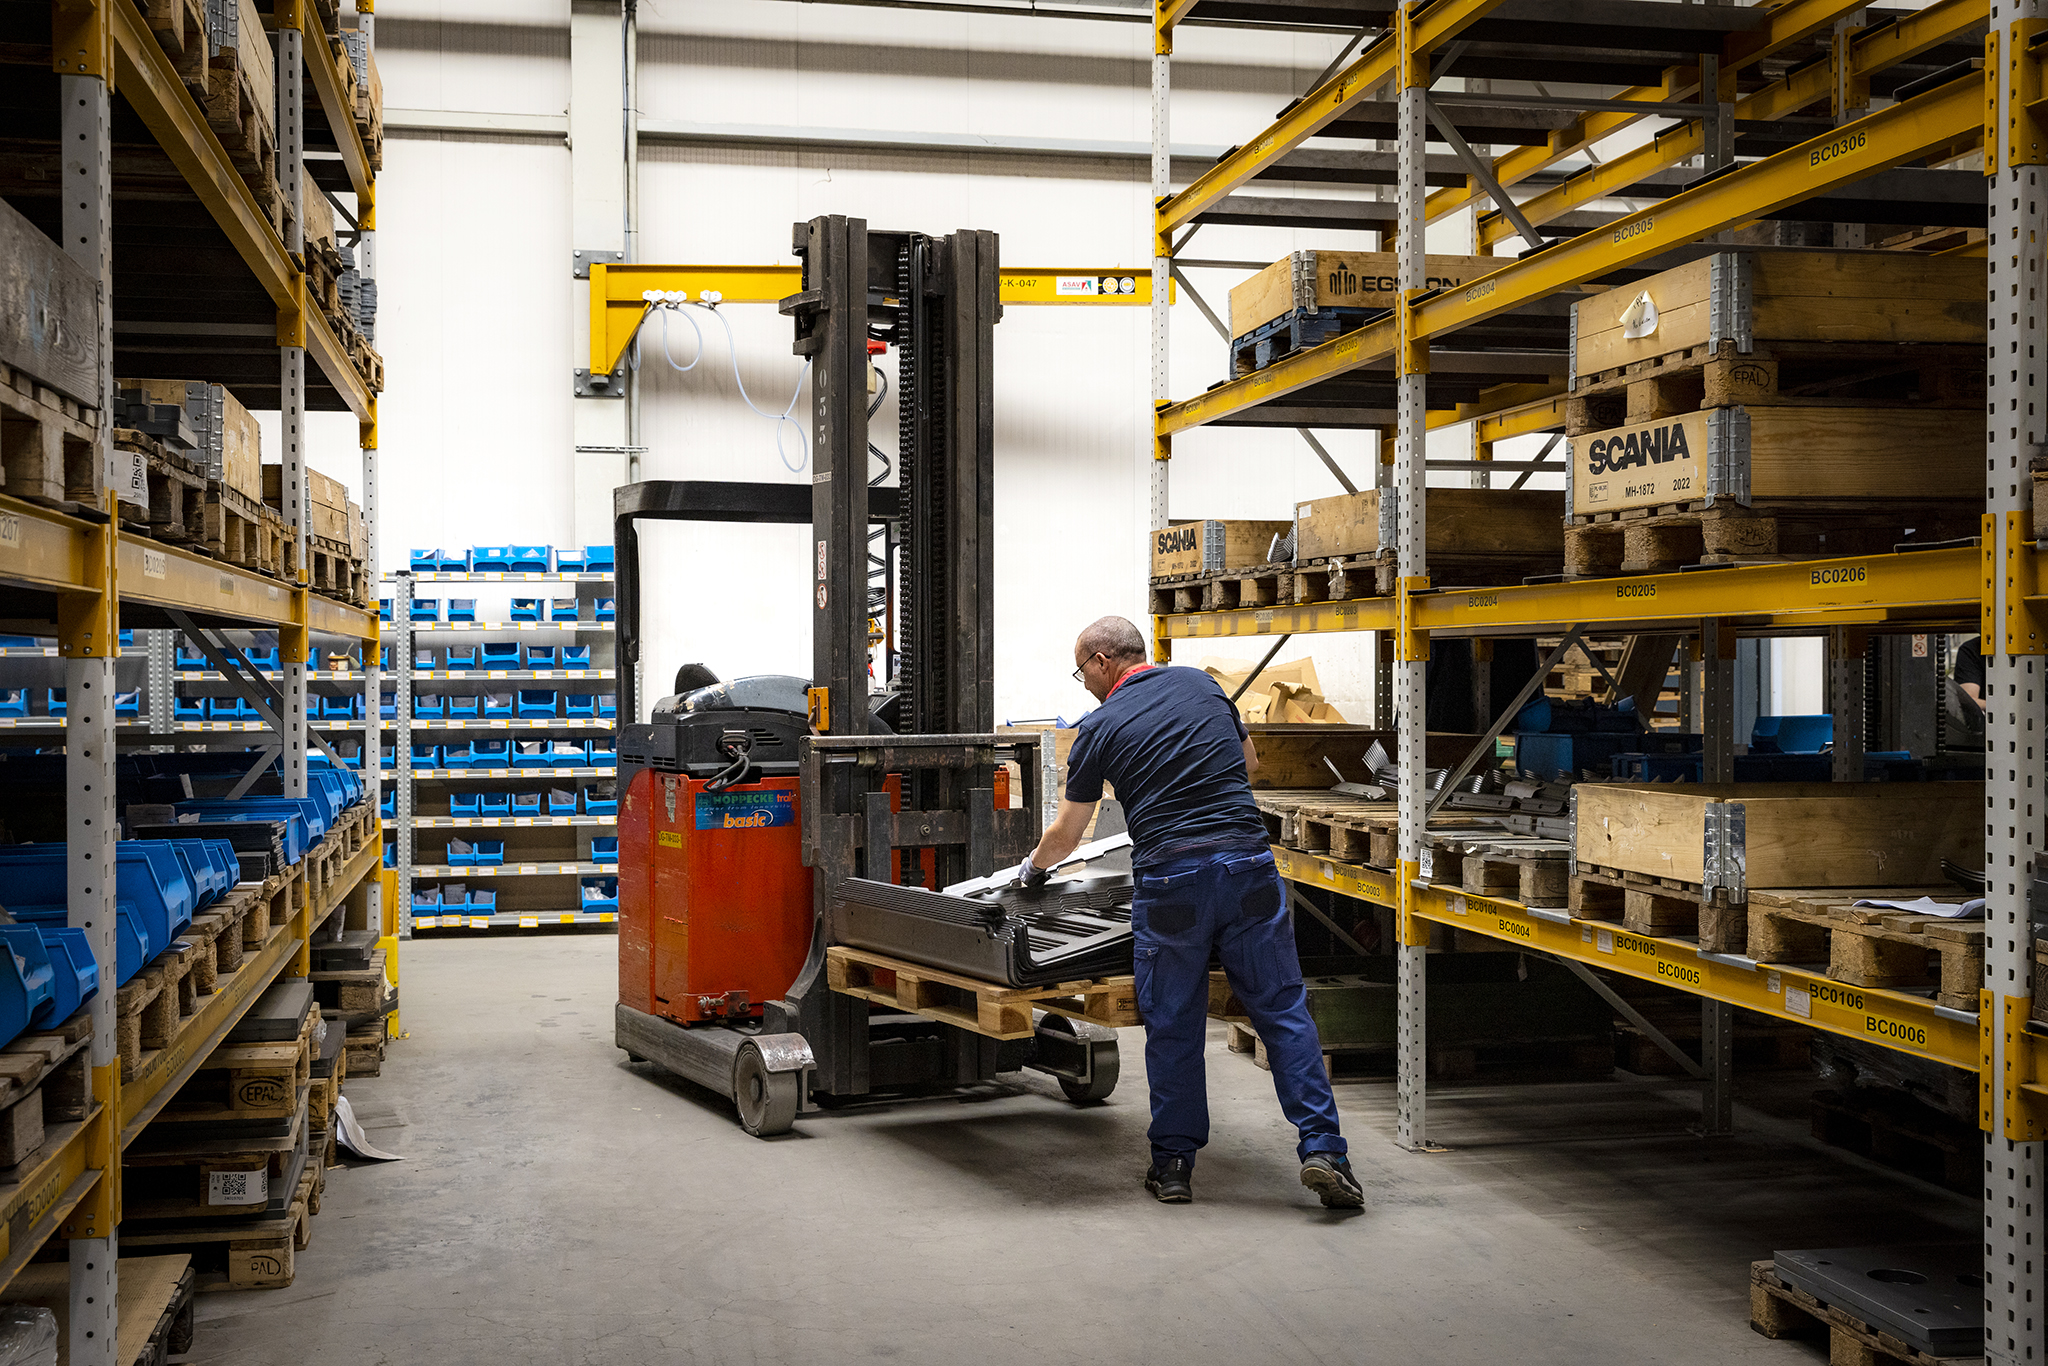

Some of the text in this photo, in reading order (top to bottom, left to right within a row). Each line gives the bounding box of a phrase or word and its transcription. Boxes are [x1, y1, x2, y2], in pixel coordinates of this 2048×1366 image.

[1810, 132, 1867, 167] BC0306
[1613, 217, 1654, 244] BC0305
[1361, 276, 1461, 292] EGON
[1466, 281, 1495, 303] BC0304
[1336, 338, 1358, 355] BC0303
[1588, 422, 1691, 476] SCANIA
[1625, 483, 1656, 499] MH-1872
[1672, 477, 1691, 492] 2022
[1158, 528, 1198, 555] SCANIA
[1811, 567, 1866, 585] BC0206
[1616, 584, 1656, 598] BC0205
[1336, 605, 1358, 616] BC0203
[1468, 595, 1498, 608] BC0204
[713, 794, 774, 805] HOPPECKE
[723, 812, 767, 828] basic
[1335, 865, 1358, 880] BC0103
[1357, 882, 1381, 897] BC0003
[1467, 899, 1498, 916] BC0104
[1499, 919, 1531, 938] BC0004
[1616, 936, 1656, 956] BC0105
[1656, 961, 1700, 984] BC0005
[1809, 983, 1864, 1010] BC0106
[1866, 1016, 1926, 1045] BC0006
[246, 1086, 278, 1102] EPAL
[28, 1172, 61, 1225] BD0007
